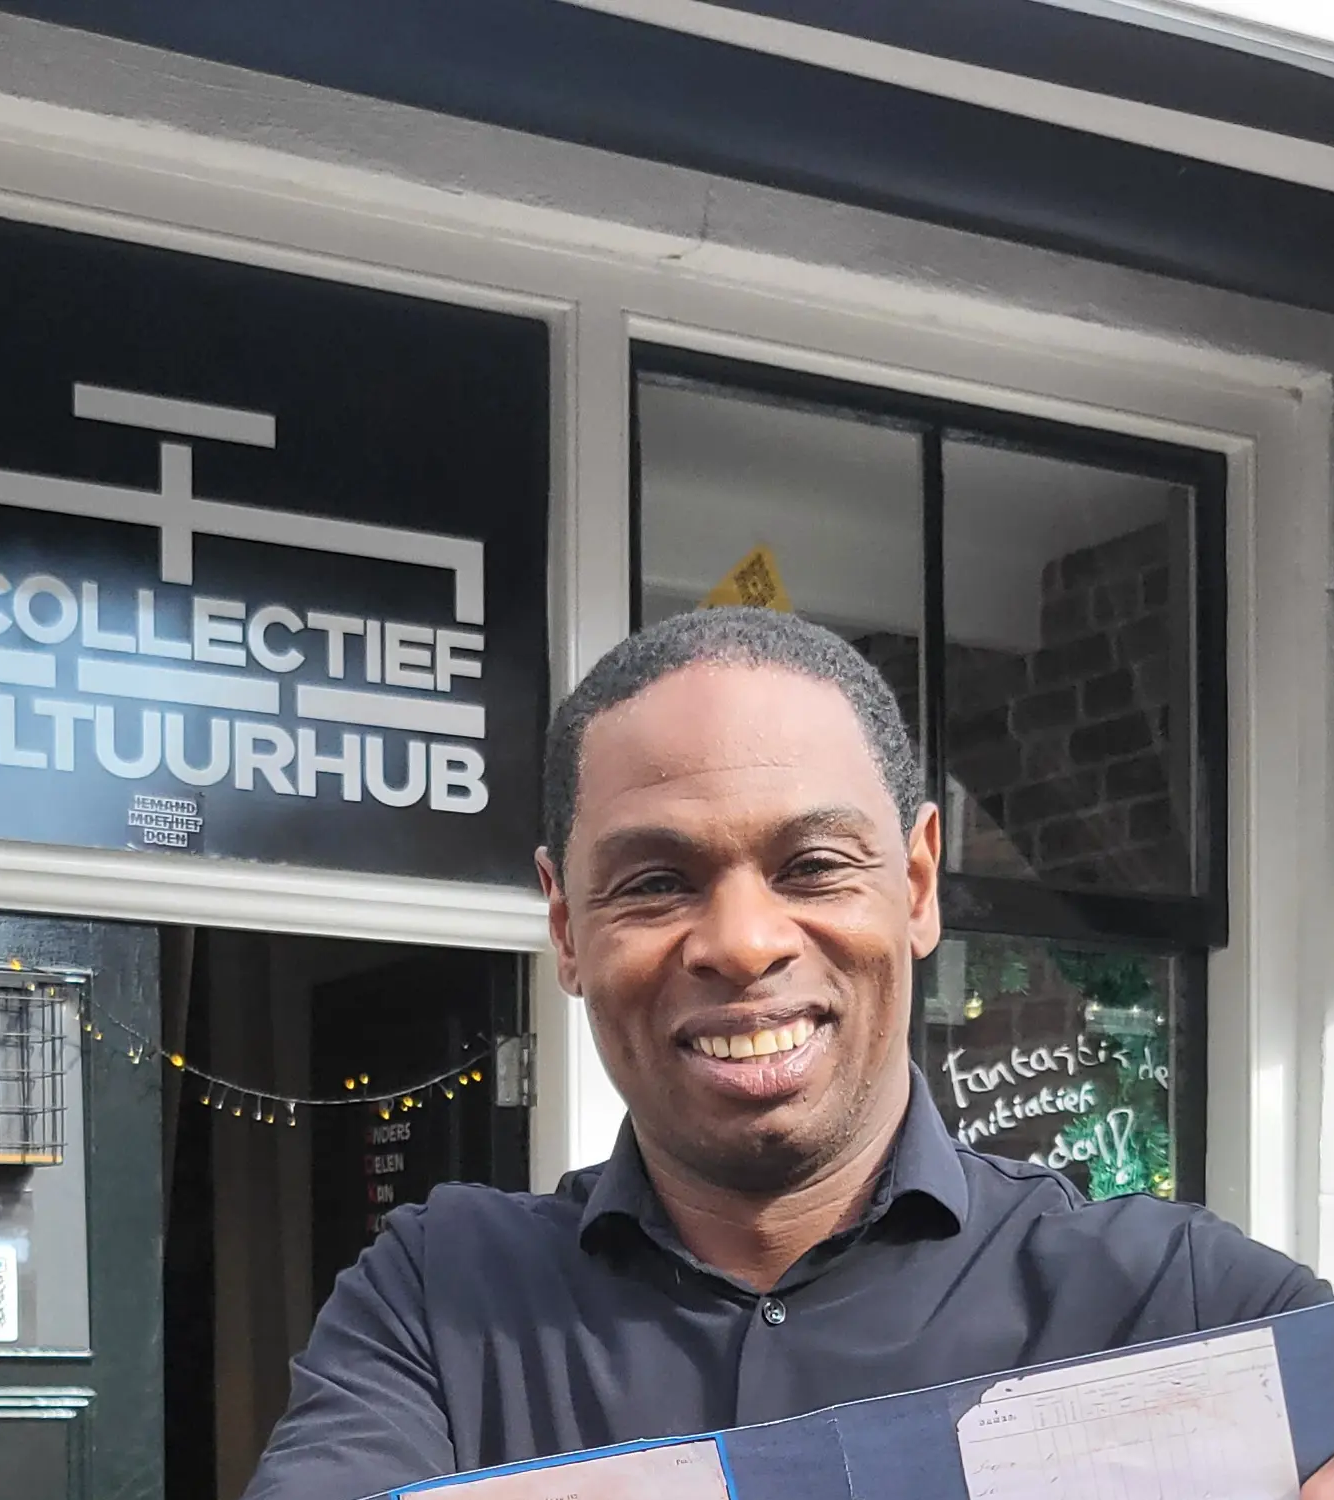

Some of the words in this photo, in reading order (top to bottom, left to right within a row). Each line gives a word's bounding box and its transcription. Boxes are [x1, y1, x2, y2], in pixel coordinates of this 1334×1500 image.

[135, 794, 197, 816] IEMAND
[128, 811, 172, 829] MOET
[172, 815, 203, 832] HET
[144, 828, 188, 847] DOEN
